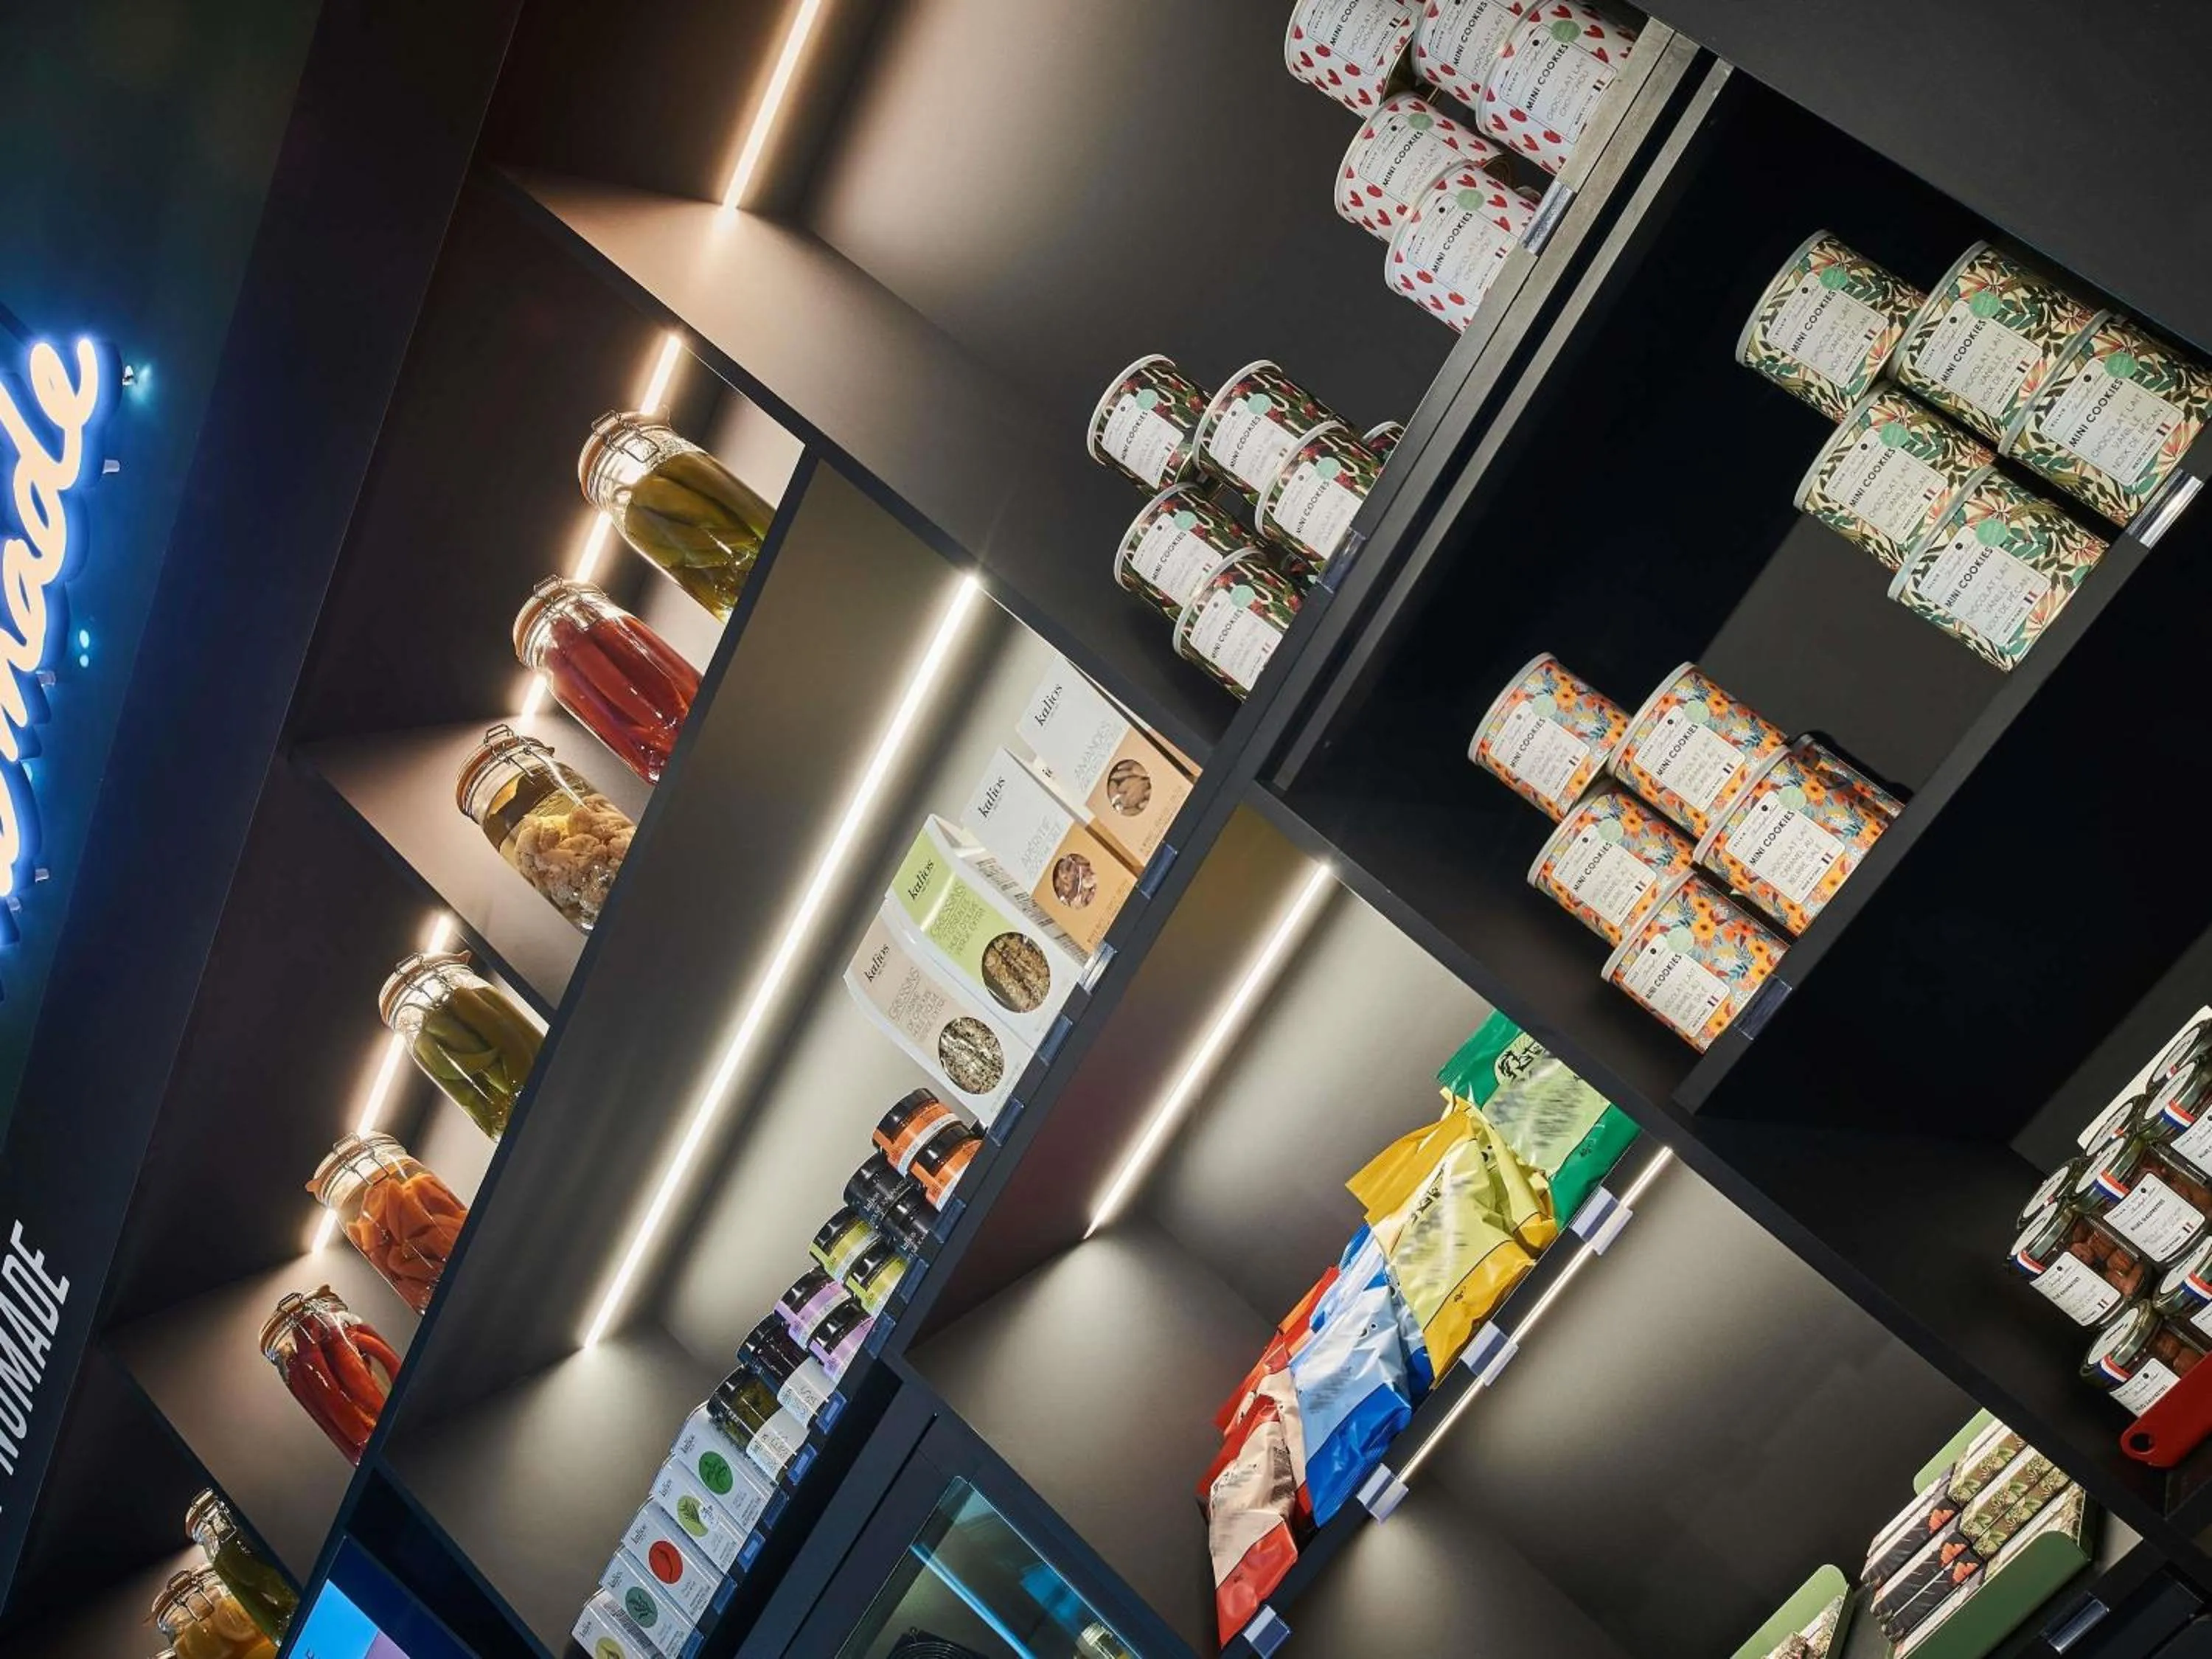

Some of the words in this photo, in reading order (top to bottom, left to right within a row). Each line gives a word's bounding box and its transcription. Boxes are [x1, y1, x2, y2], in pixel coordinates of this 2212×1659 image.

[1329, 23, 1343, 46] MINI
[1452, 43, 1464, 66] MINI
[1459, 0, 1488, 44] COOKIES
[1525, 86, 1540, 111] MINI
[1536, 42, 1569, 86] COOKIES
[1380, 164, 1397, 187] MINI
[1393, 130, 1424, 165] COOKIES
[1430, 251, 1446, 274] MINI
[1441, 210, 1473, 251] COOKIES
[1790, 330, 1807, 353] MINI
[1803, 288, 1837, 332] COOKIES
[1939, 362, 1956, 383] MINI
[1952, 318, 1986, 363] COOKIES
[1124, 409, 1149, 445] COOKIES
[2068, 422, 2089, 447] MINI
[2084, 377, 2124, 424] COOKIES
[2090, 412, 2127, 458] CHOCOLAT
[2124, 392, 2143, 413] LAIT
[2111, 414, 2142, 450] VANILLE
[1119, 443, 1130, 461] MINI
[1228, 450, 1240, 468] MINI
[1235, 414, 1262, 451] COOKIES
[2112, 448, 2132, 470] NOIX
[2128, 437, 2140, 449] DE
[1849, 487, 1865, 507] MINI
[1861, 446, 1896, 487] COOKIES
[1295, 516, 1307, 535] MINI
[1302, 479, 1329, 517] COOKIES
[1150, 562, 1163, 581] MINI
[1158, 529, 1186, 563] COOKIES
[1944, 588, 1961, 608] MINI
[1957, 545, 1993, 589] COOKIES
[1964, 579, 1997, 620] CHOCOLAT
[1994, 560, 2011, 580] LAIT
[1997, 602, 2010, 614] DE
[1210, 640, 1222, 659] MINI
[1217, 607, 1244, 643] COOKIES
[1033, 681, 1063, 726] kalios
[1509, 751, 1522, 768] MINI
[1517, 716, 1546, 752] COOKIES
[1655, 758, 1672, 776] MINI
[1667, 723, 1699, 759] COOKIES
[976, 773, 1006, 818] kalios
[1748, 846, 1766, 866] MINI
[1761, 809, 1795, 848] COOKIES
[905, 857, 936, 900] kalios
[1572, 874, 1586, 892] MINI
[1583, 841, 1613, 876] COOKIES
[861, 940, 891, 982] kalios
[1645, 985, 1658, 999] MINI
[1652, 953, 1683, 988] COOKIES
